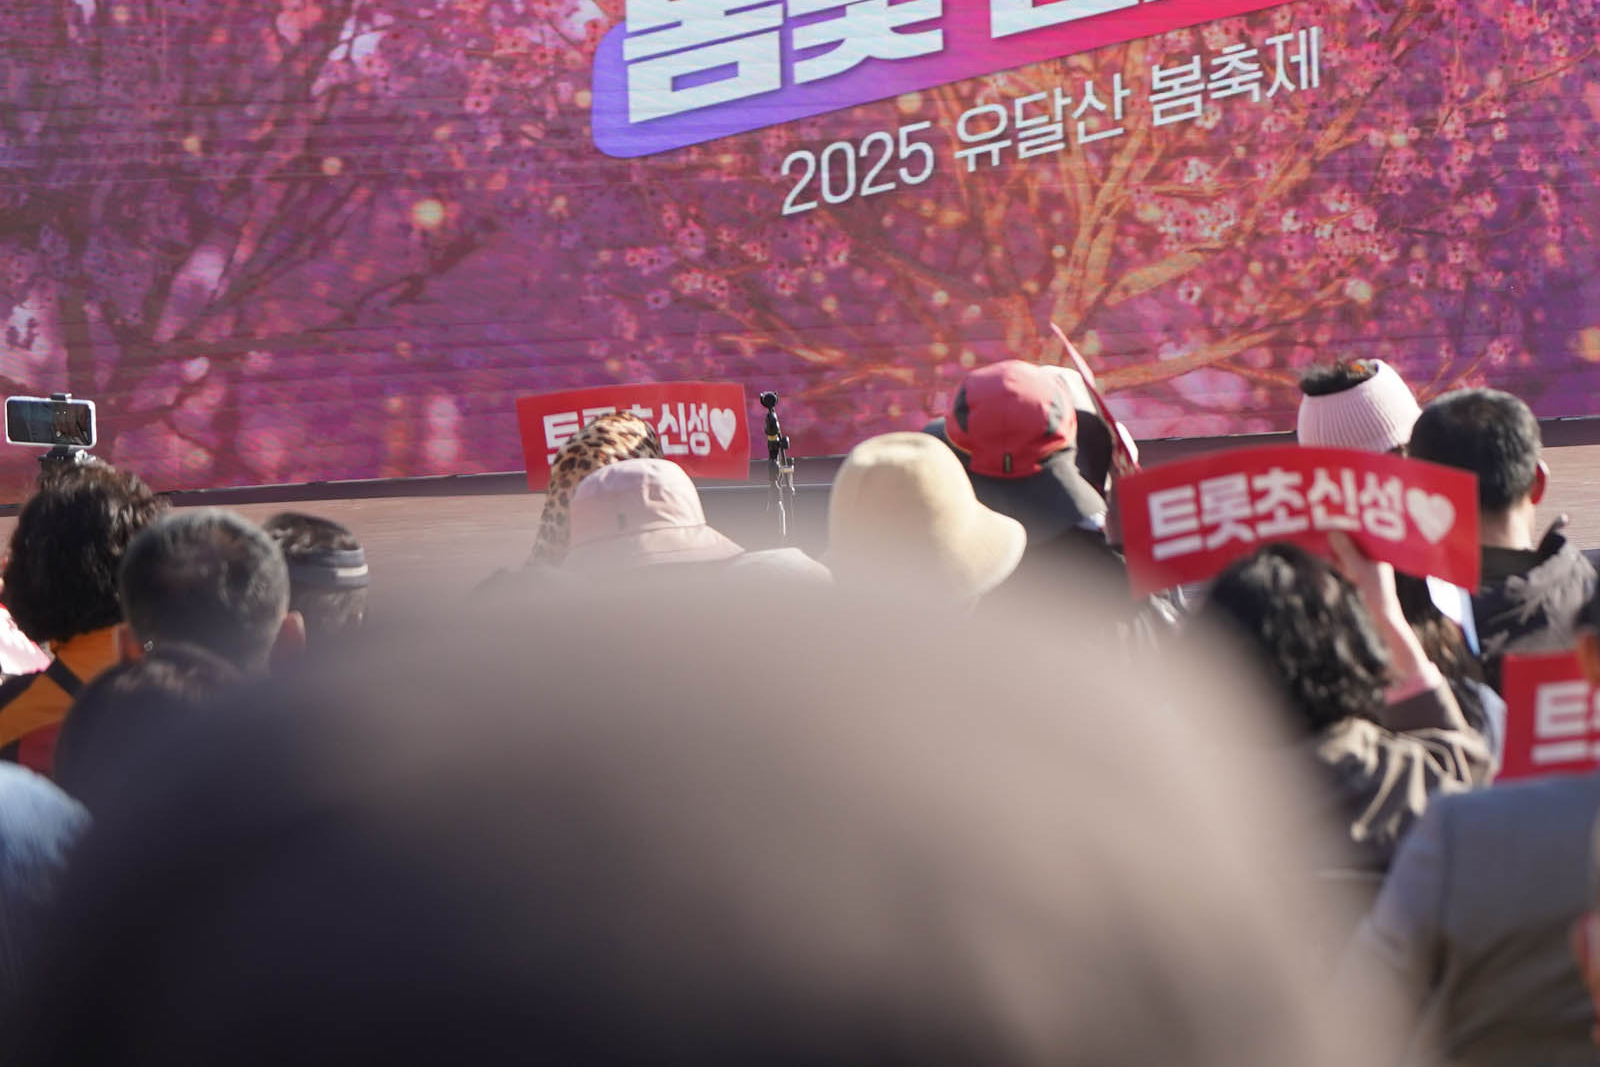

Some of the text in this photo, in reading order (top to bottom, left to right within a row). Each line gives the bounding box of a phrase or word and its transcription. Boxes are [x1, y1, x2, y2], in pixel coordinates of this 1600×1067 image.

[780, 24, 1322, 216] 2025 유달산 봄축제
